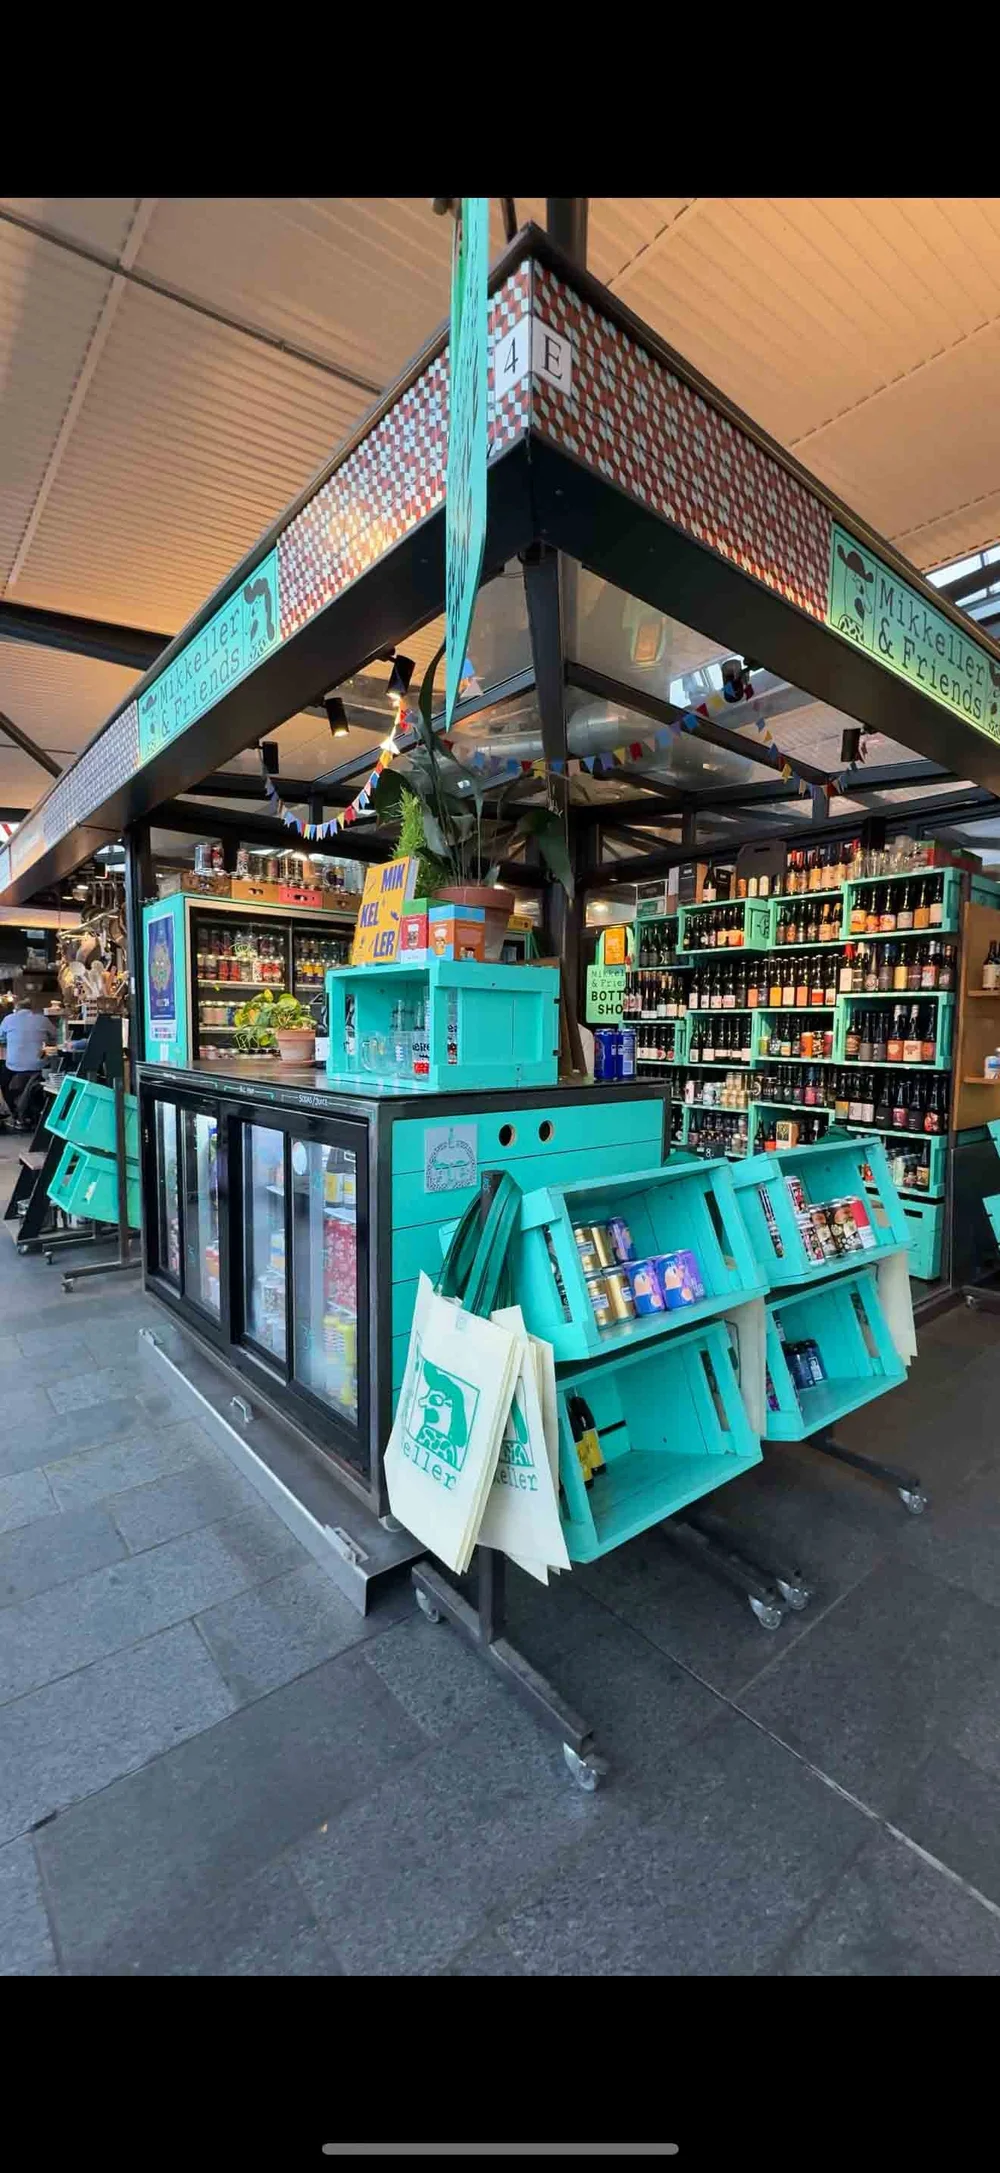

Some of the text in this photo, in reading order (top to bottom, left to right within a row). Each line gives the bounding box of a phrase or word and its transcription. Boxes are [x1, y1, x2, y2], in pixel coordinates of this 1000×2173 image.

[503, 333, 563, 380] 4 E
[879, 578, 986, 686] Mikkeller
[159, 607, 241, 710] Mikkeller
[879, 616, 983, 720] & Friends
[161, 647, 240, 737] & Friends
[381, 863, 405, 893] MIK
[360, 901, 380, 928] KEL
[373, 930, 395, 958] LER
[591, 990, 624, 1002] BOTT
[598, 1004, 623, 1015] SHO
